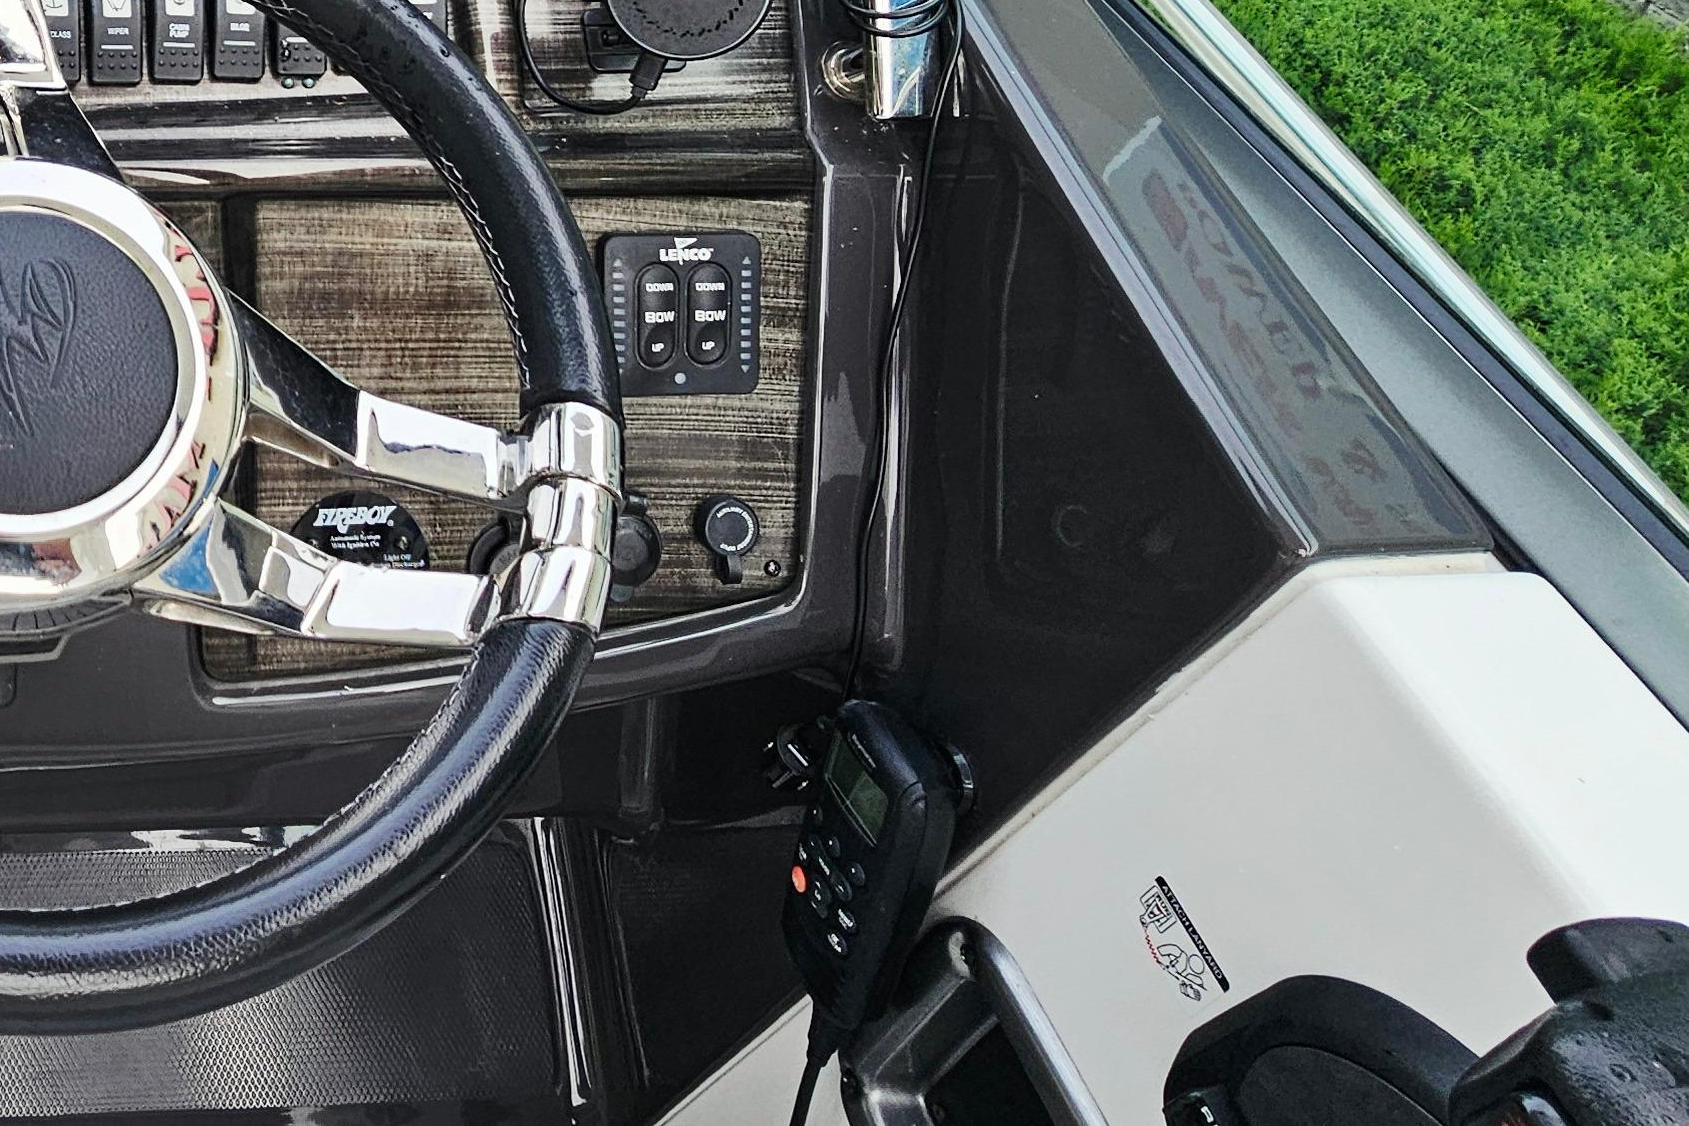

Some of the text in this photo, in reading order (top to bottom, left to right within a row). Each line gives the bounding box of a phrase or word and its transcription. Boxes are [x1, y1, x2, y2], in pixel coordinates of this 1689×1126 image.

[50, 30, 72, 39] DLASS
[659, 248, 713, 263] LENCO
[645, 282, 674, 292] DOWN
[695, 282, 725, 292] DOWN
[645, 310, 675, 323] BOW
[695, 310, 726, 322] BOW
[651, 342, 664, 352] UP
[702, 341, 715, 350] UP
[313, 506, 397, 534] FIREBOY
[1162, 885, 1223, 980] ATTACH LANYARD
